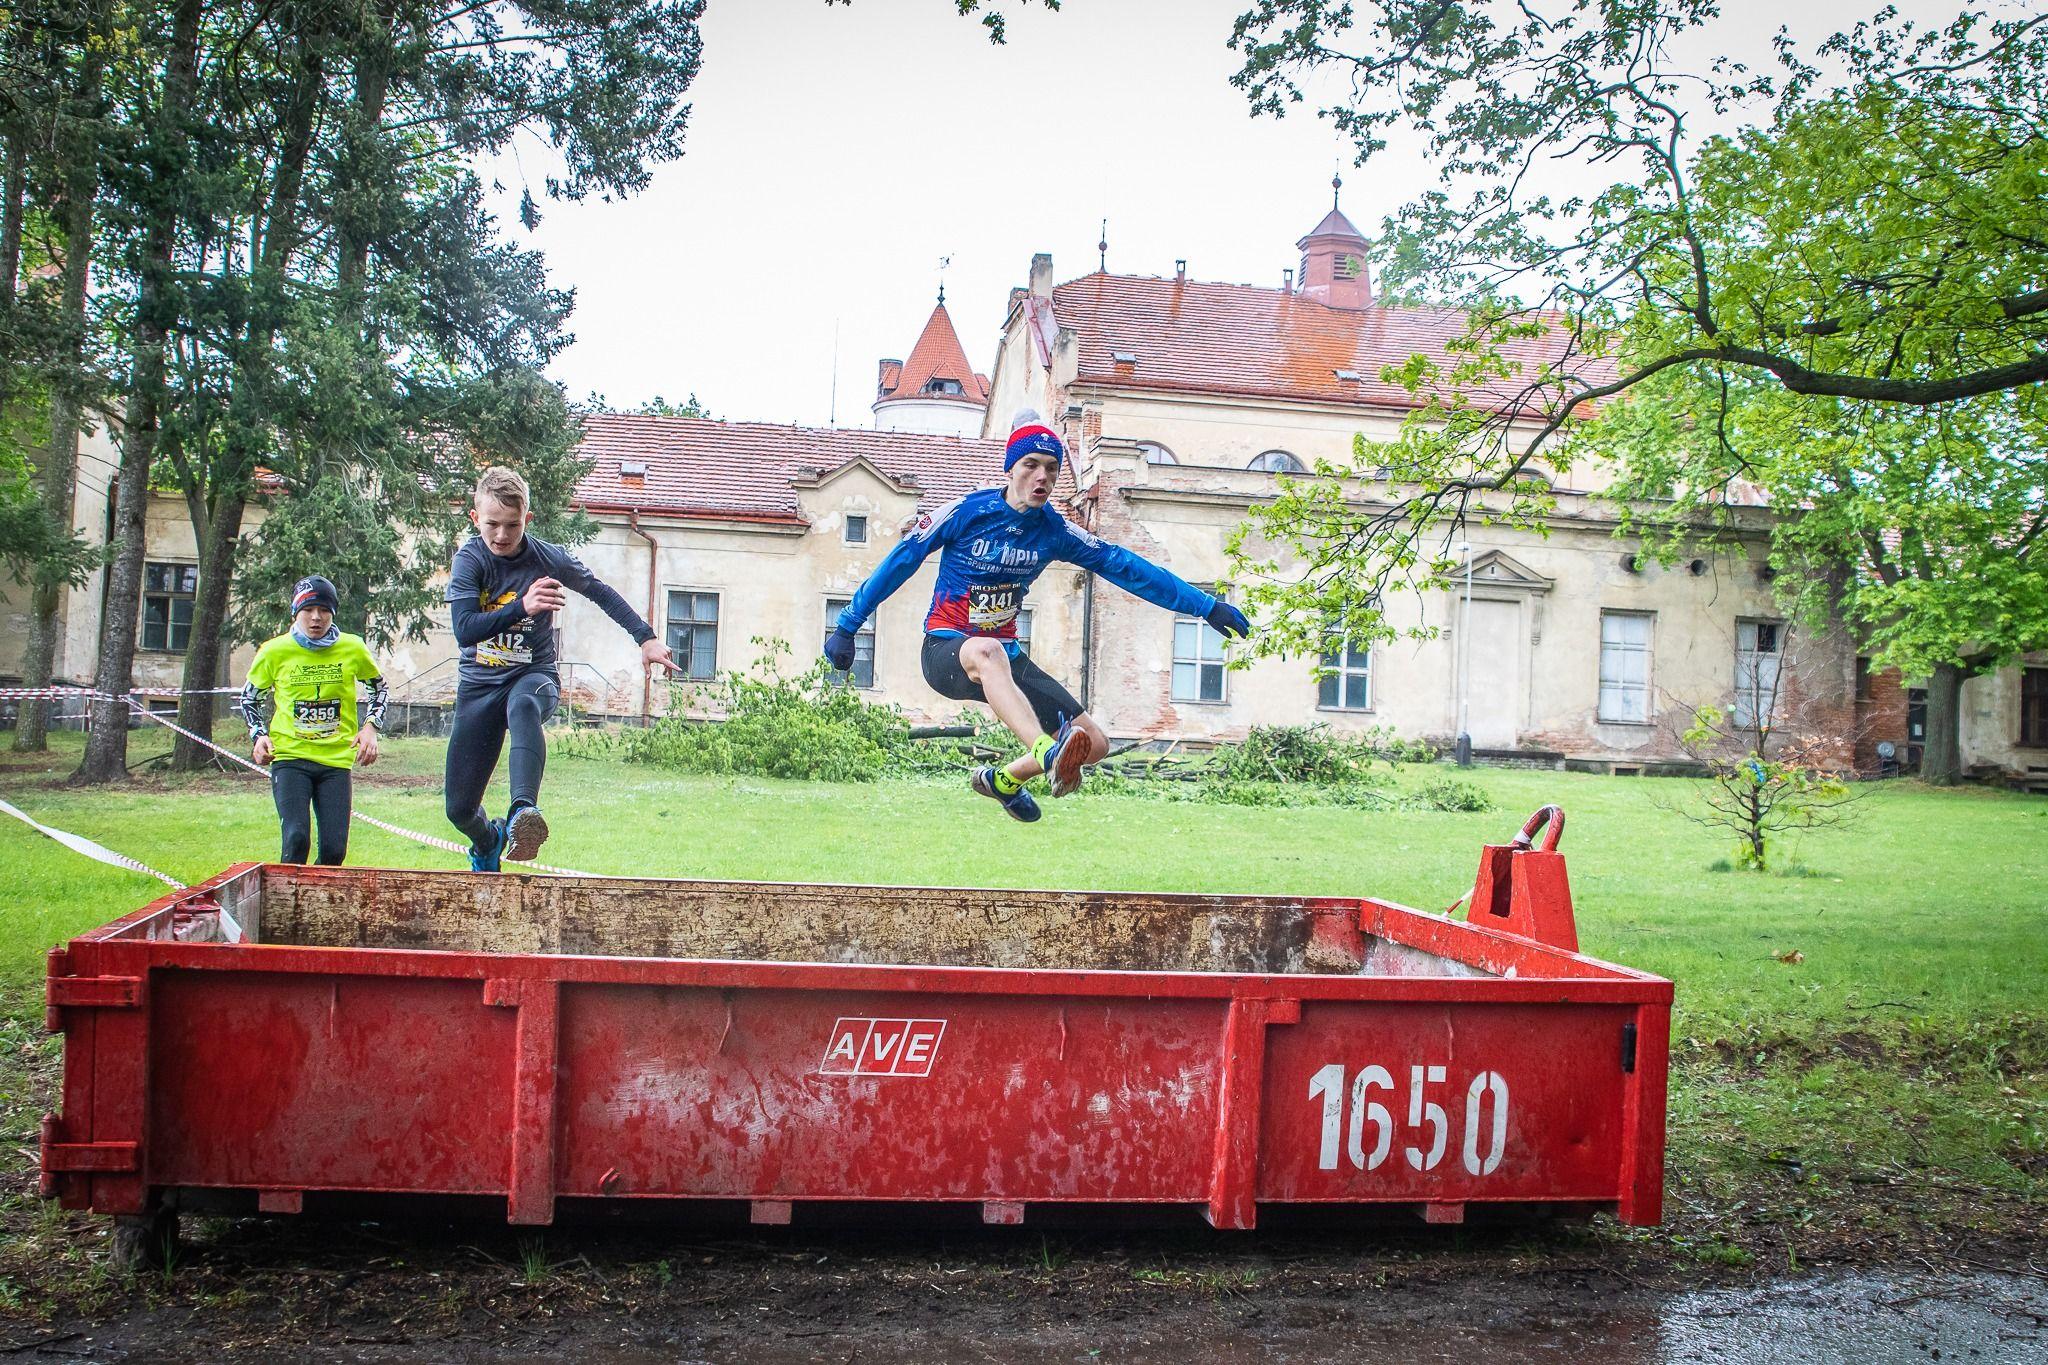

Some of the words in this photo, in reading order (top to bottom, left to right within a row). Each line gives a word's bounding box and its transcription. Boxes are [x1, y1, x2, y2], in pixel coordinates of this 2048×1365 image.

[978, 592, 1013, 611] 2141
[495, 632, 525, 650] 112
[300, 707, 336, 721] 2359
[828, 1032, 935, 1063] AVE
[1308, 1064, 1510, 1176] 1650
